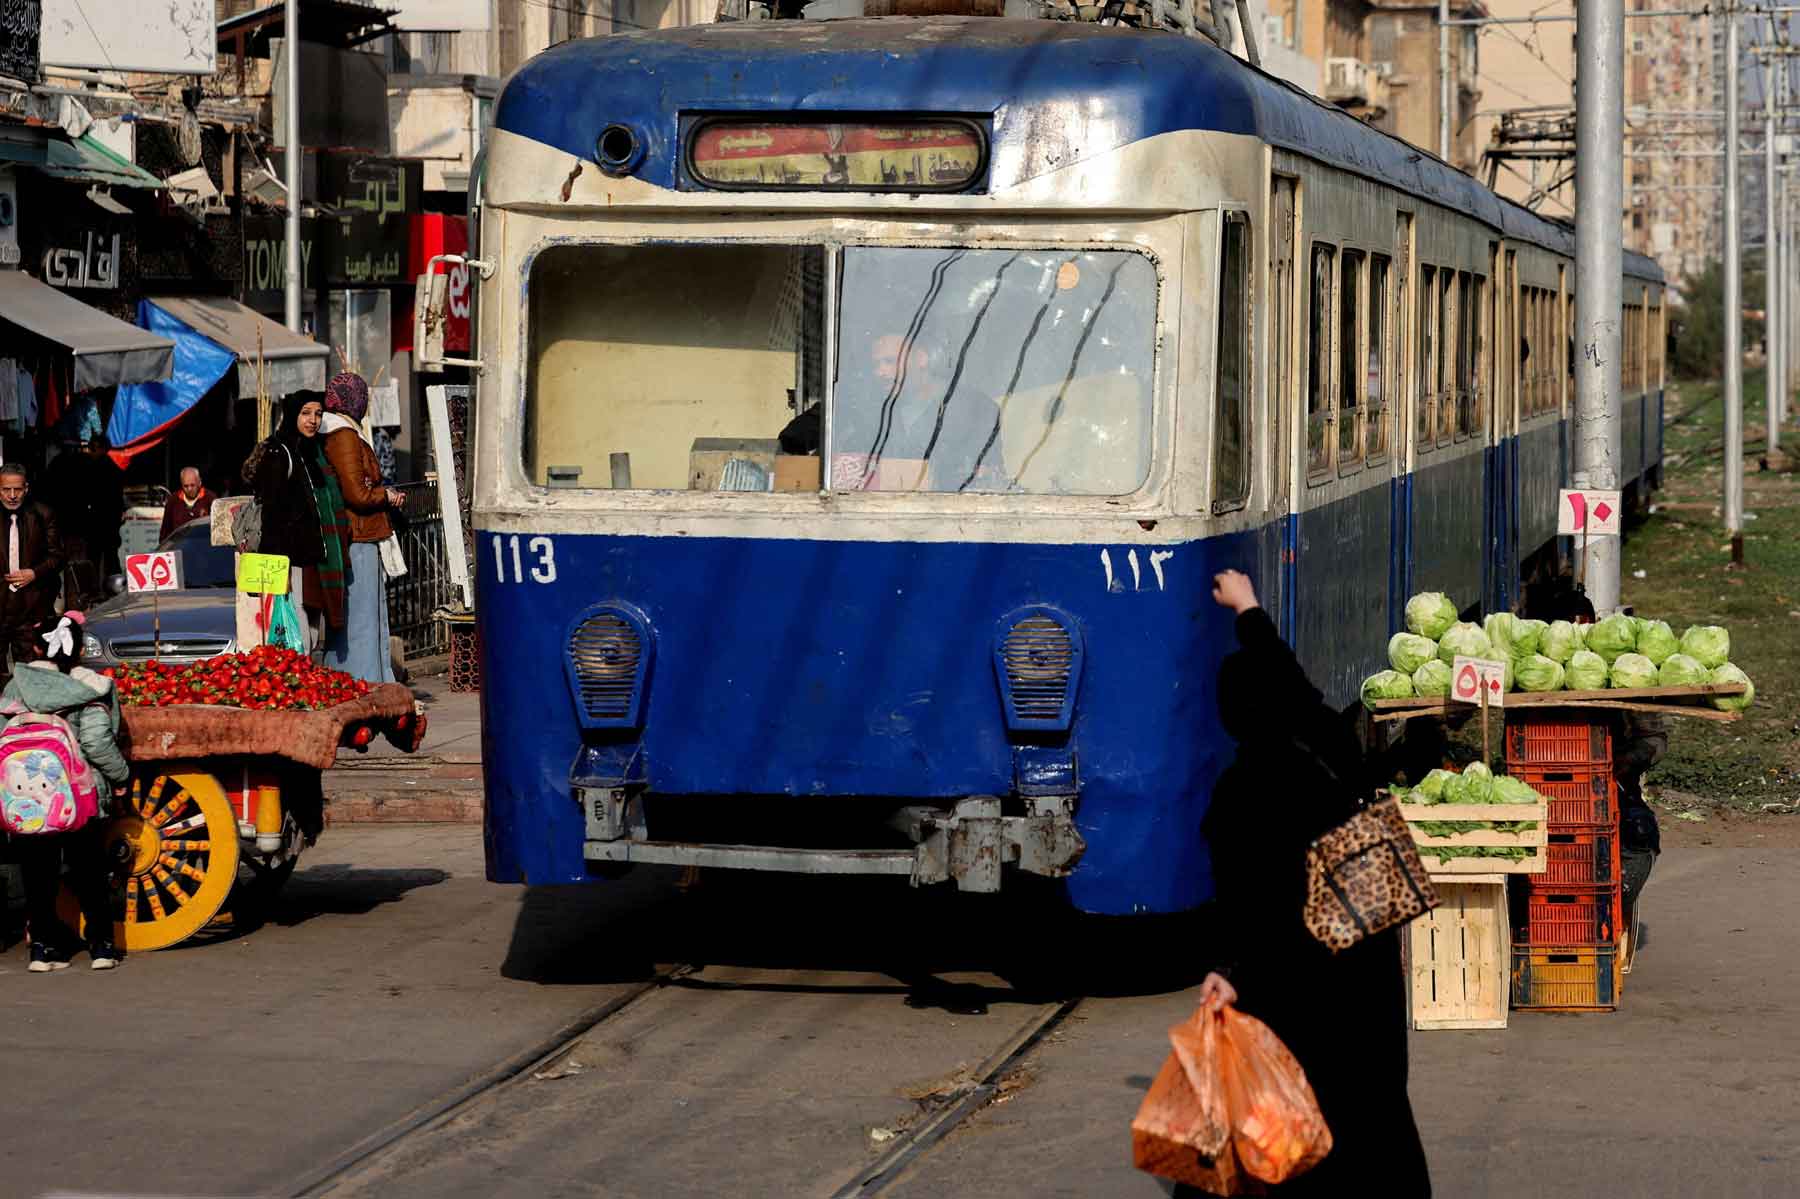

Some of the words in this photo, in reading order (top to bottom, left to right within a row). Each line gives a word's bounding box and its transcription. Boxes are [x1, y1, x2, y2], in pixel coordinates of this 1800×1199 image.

[246, 239, 312, 290] TOMY
[126, 554, 170, 590] ٢٥
[493, 535, 557, 583] 113
[1101, 548, 1174, 592] ١١٣
